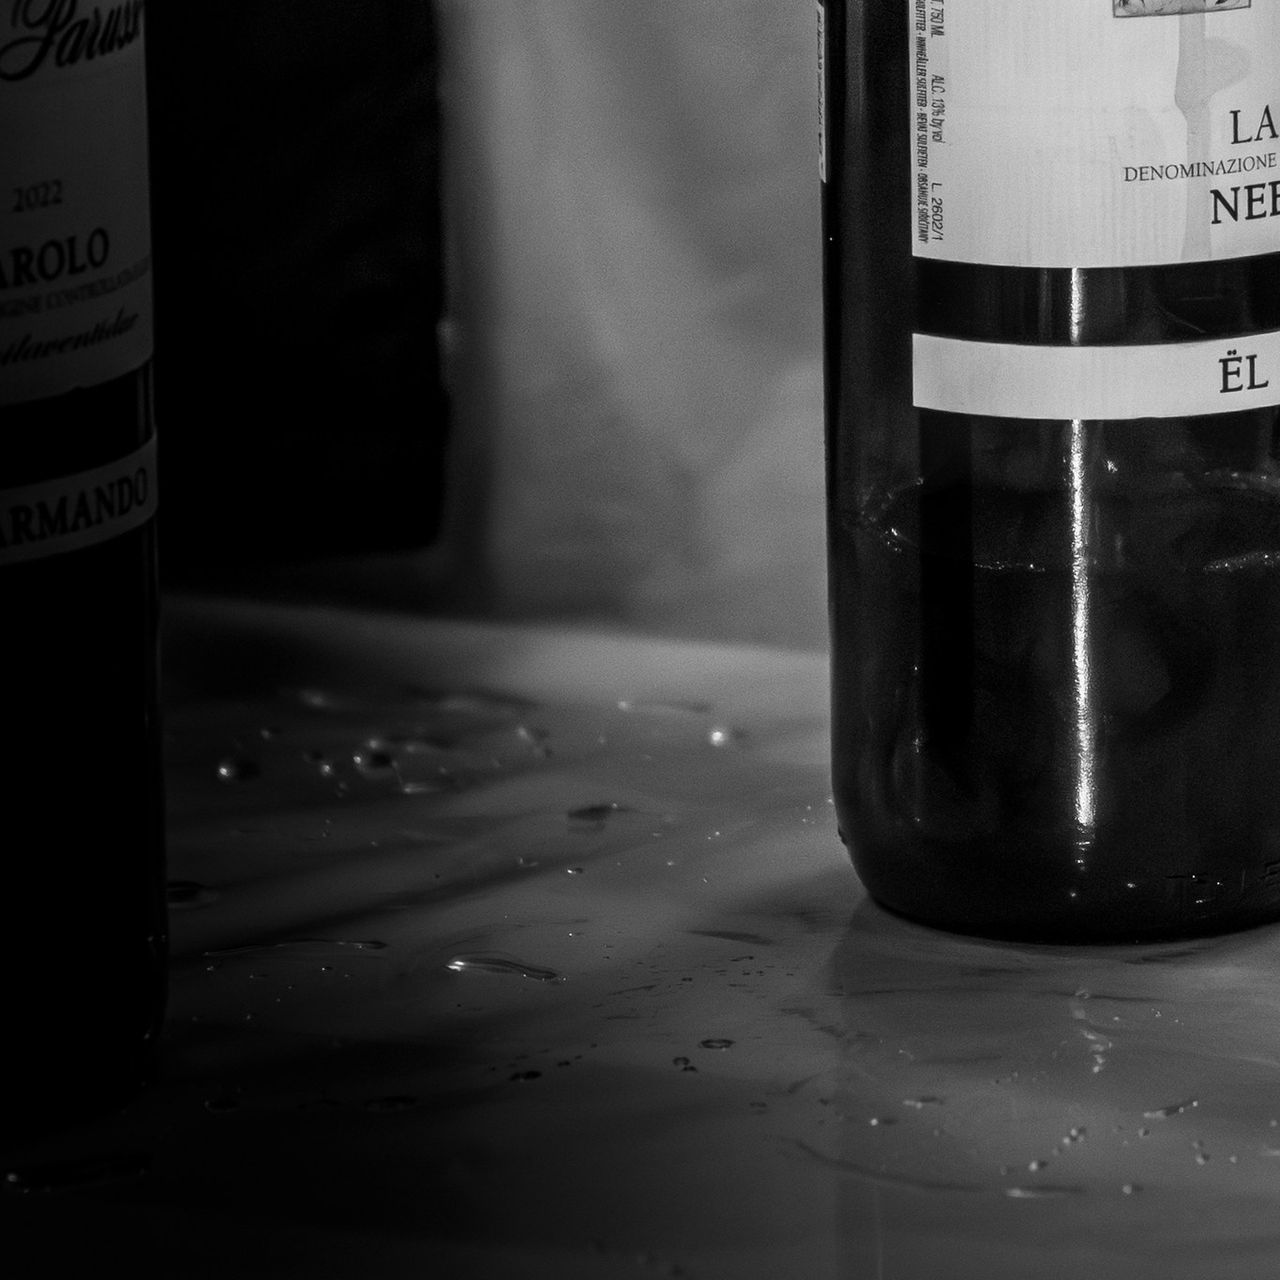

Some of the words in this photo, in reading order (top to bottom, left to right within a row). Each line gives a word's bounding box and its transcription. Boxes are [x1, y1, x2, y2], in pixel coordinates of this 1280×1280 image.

[930, 7, 945, 24] 750
[930, 25, 945, 38] ML
[931, 74, 946, 95] ALC.
[931, 98, 946, 117] 13%
[929, 118, 946, 131] by
[931, 130, 946, 144] vol
[1123, 152, 1277, 182] DENOMINAZIONE
[12, 178, 63, 213] 2022
[931, 197, 944, 241] 2602/1
[1218, 349, 1269, 394] ËL
